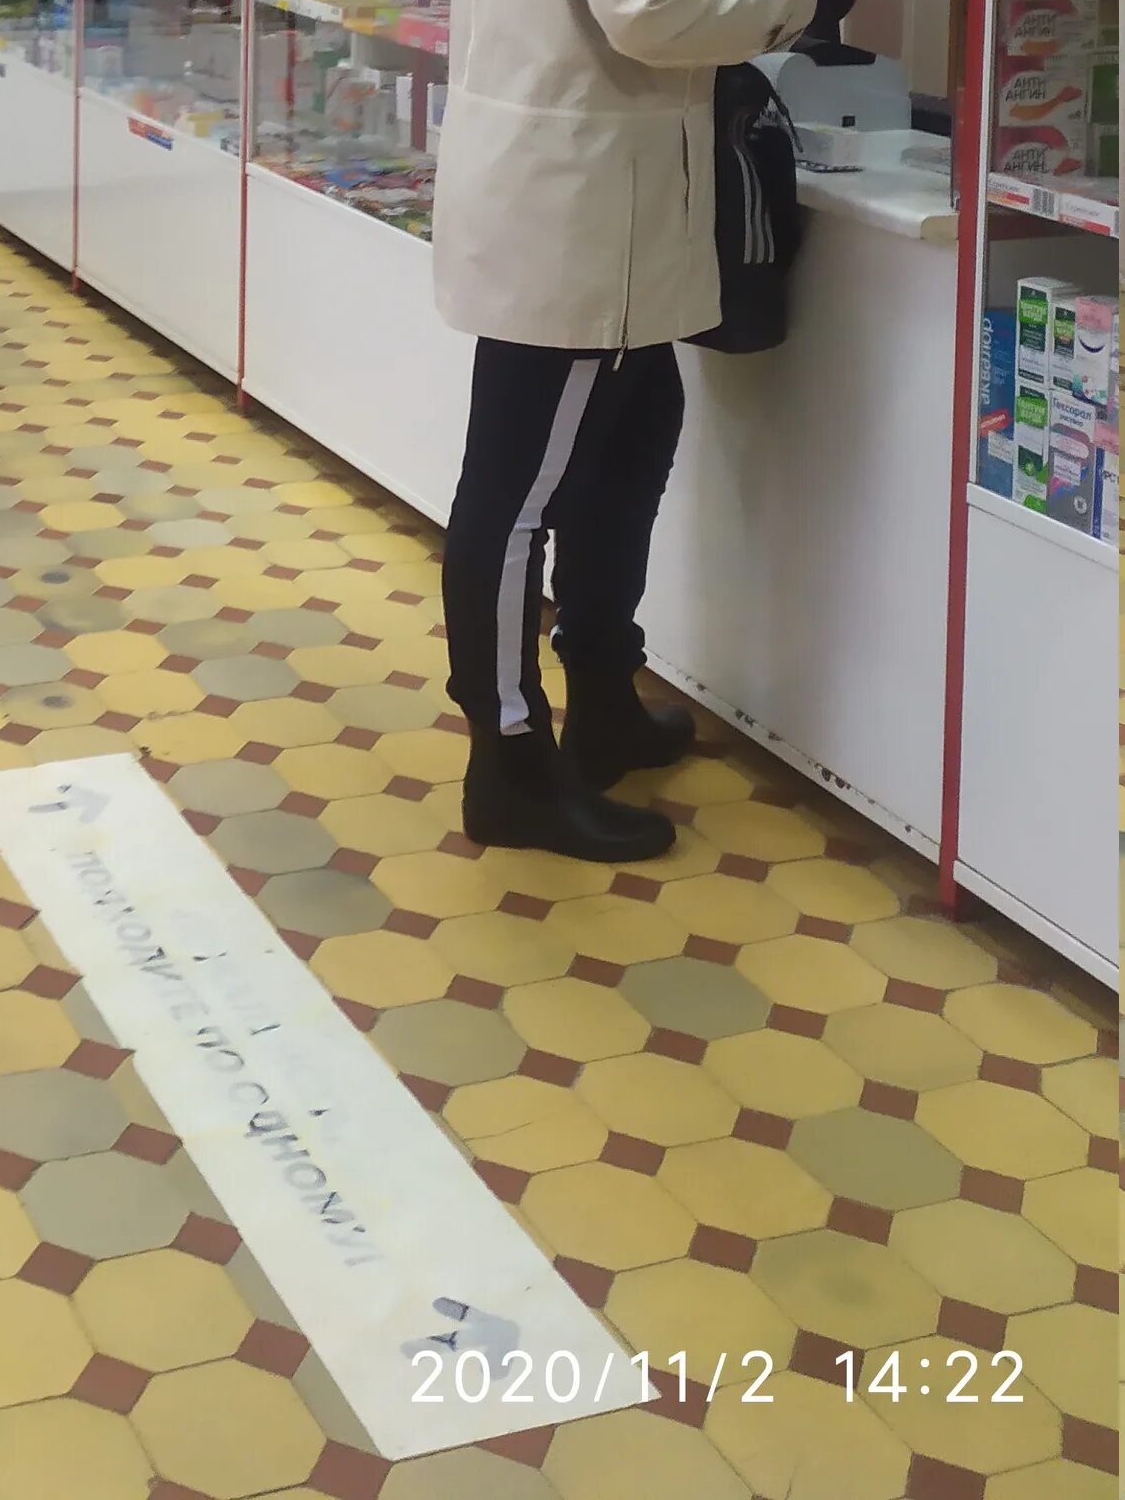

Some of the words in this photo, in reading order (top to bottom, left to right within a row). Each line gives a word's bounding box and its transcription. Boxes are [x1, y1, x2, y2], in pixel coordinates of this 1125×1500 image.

[1022, 13, 1058, 26] АНТИ
[1014, 25, 1056, 39] АНГИН
[1013, 76, 1046, 89] АНТИ
[1005, 88, 1046, 101] АНГИН
[1011, 149, 1046, 160] АНТИ
[1003, 159, 1045, 173] АНГИН
[63, 849, 211, 1023] ПОДХОДИТЕ
[193, 1026, 245, 1073] ПО
